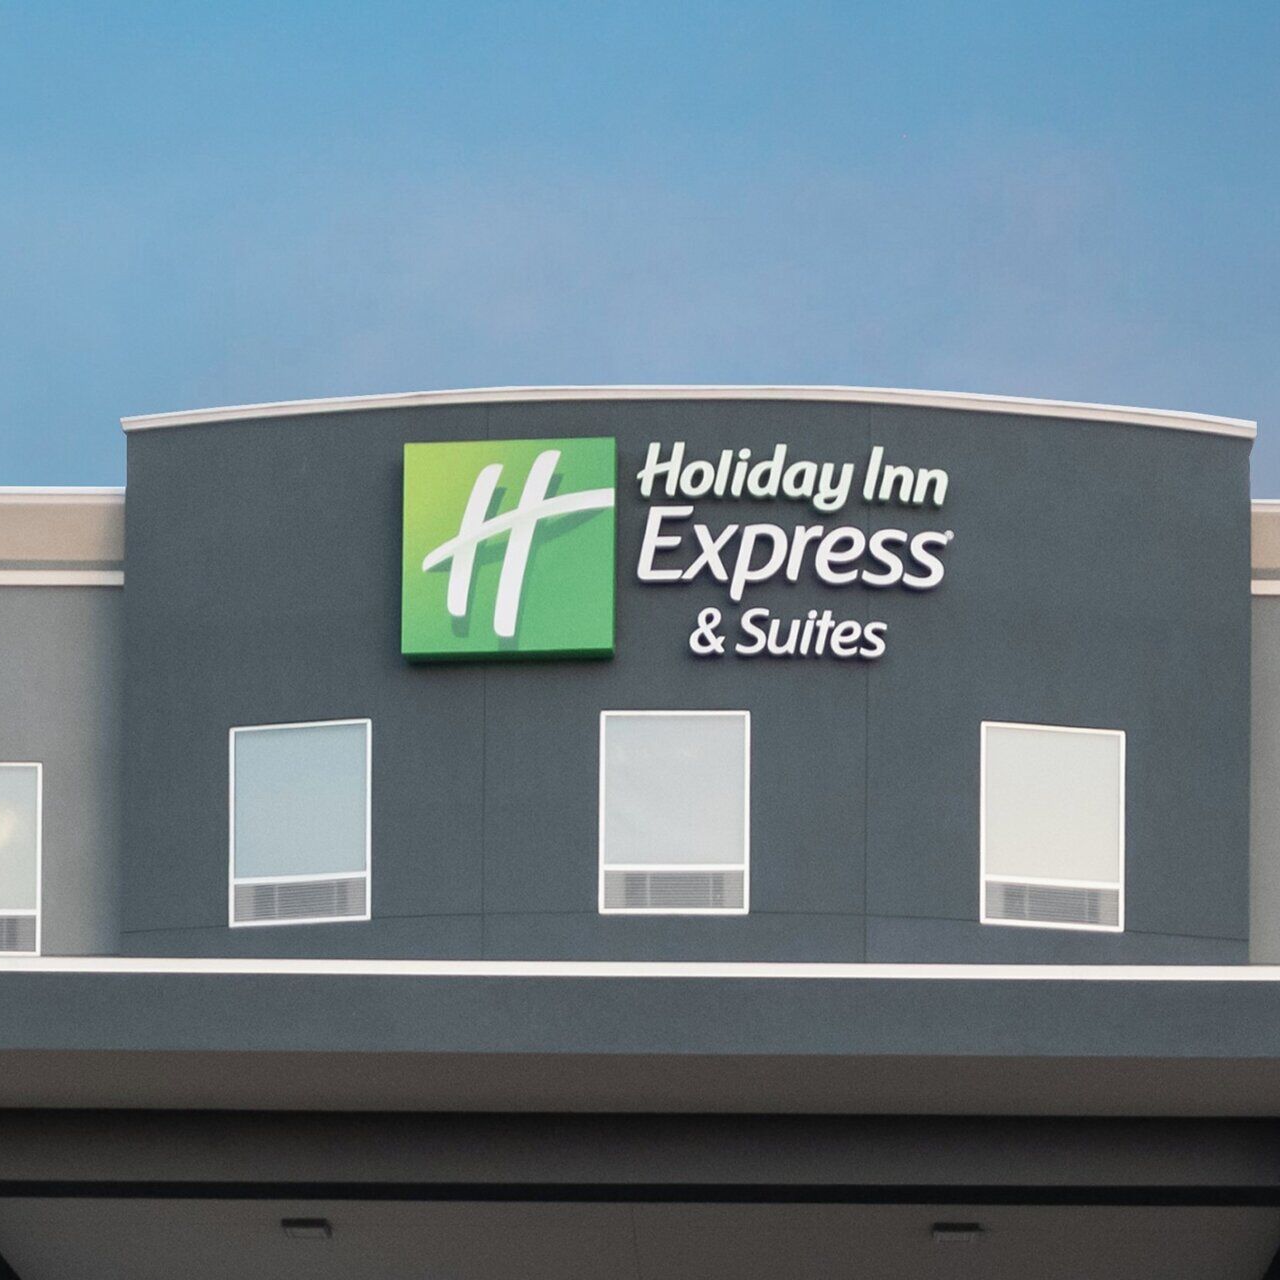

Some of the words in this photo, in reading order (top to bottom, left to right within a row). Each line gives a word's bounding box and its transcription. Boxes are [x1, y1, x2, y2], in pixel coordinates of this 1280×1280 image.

[636, 441, 855, 511] Holiday
[862, 445, 949, 506] Inn
[636, 505, 946, 602] Express
[689, 607, 726, 655] &
[735, 607, 888, 658] Suites
